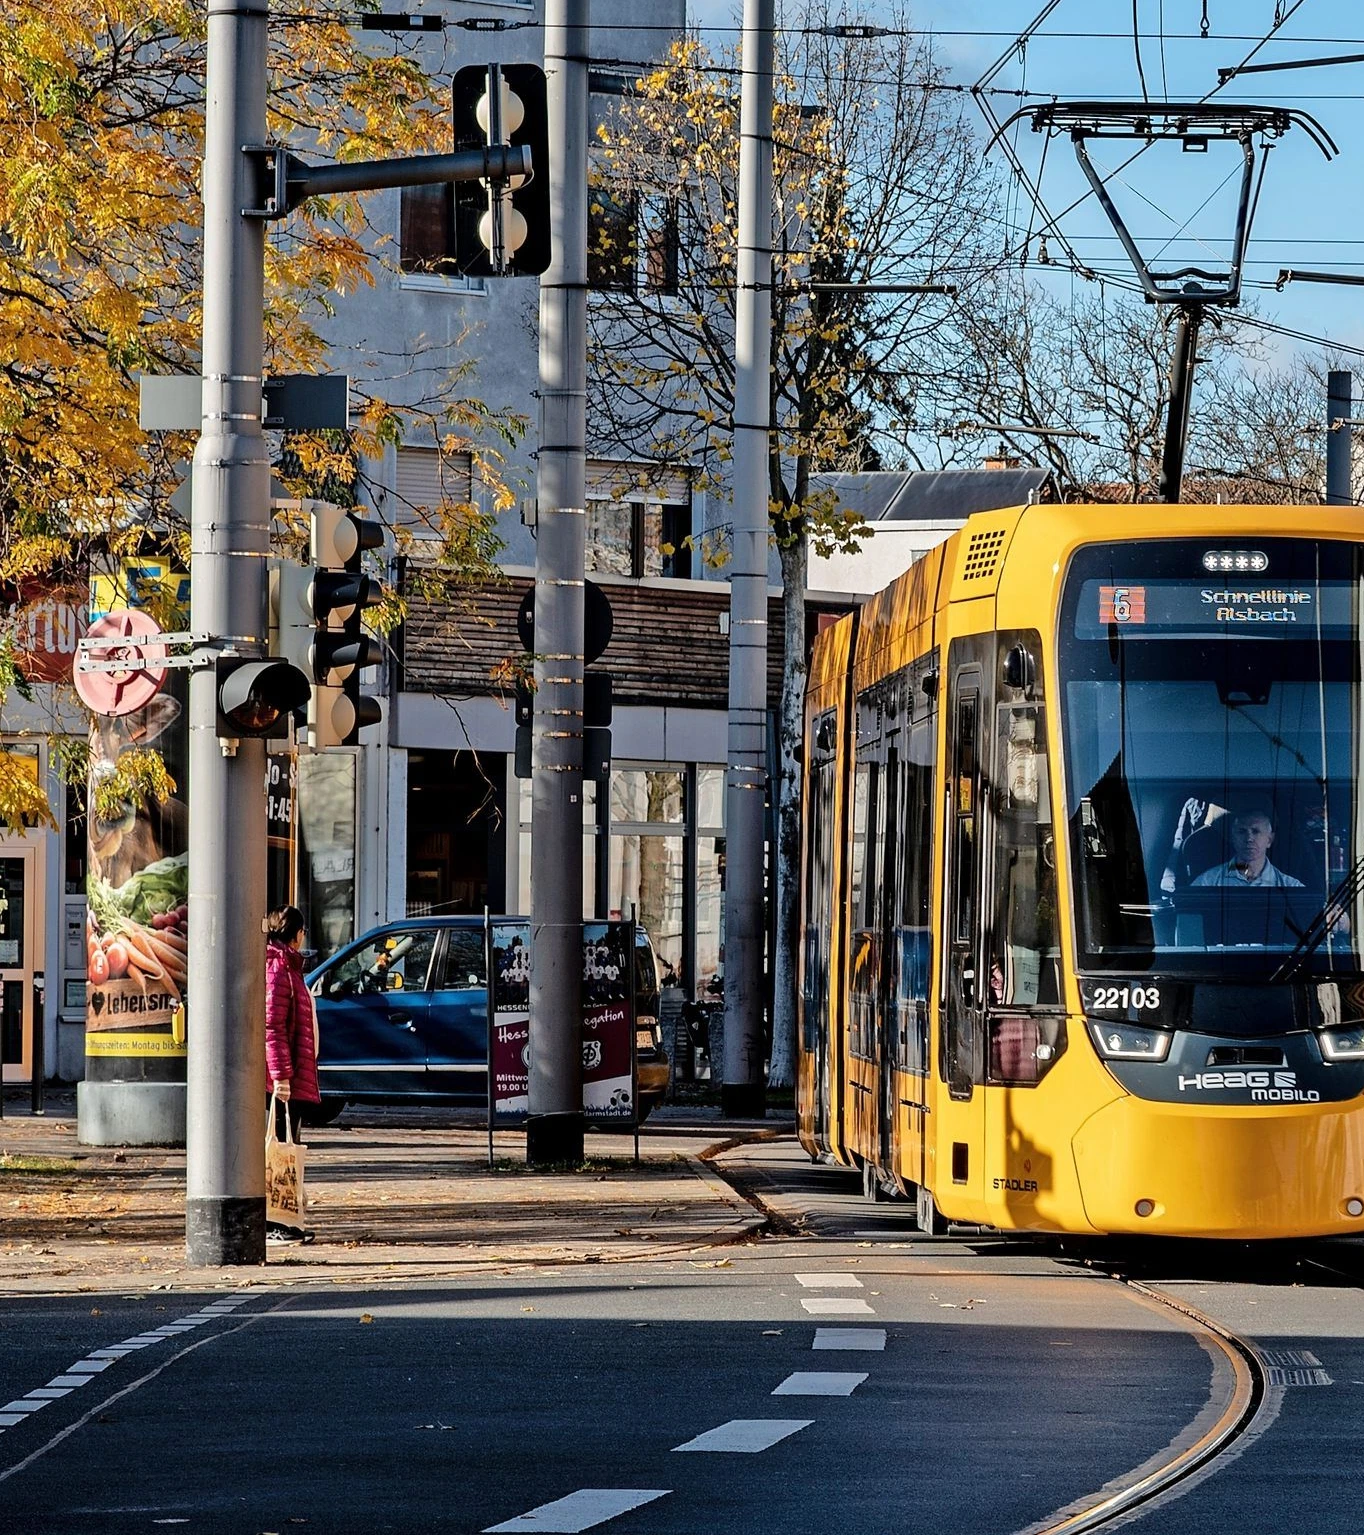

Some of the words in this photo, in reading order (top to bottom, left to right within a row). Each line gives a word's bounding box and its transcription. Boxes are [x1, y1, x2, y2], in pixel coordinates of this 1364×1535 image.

[1114, 588, 1131, 621] 6
[1216, 607, 1297, 622] Alsbach
[1093, 987, 1160, 1009] 22103
[131, 1041, 160, 1052] Montag
[497, 1083, 520, 1092] 19.00
[993, 1178, 1038, 1192] STADLER
